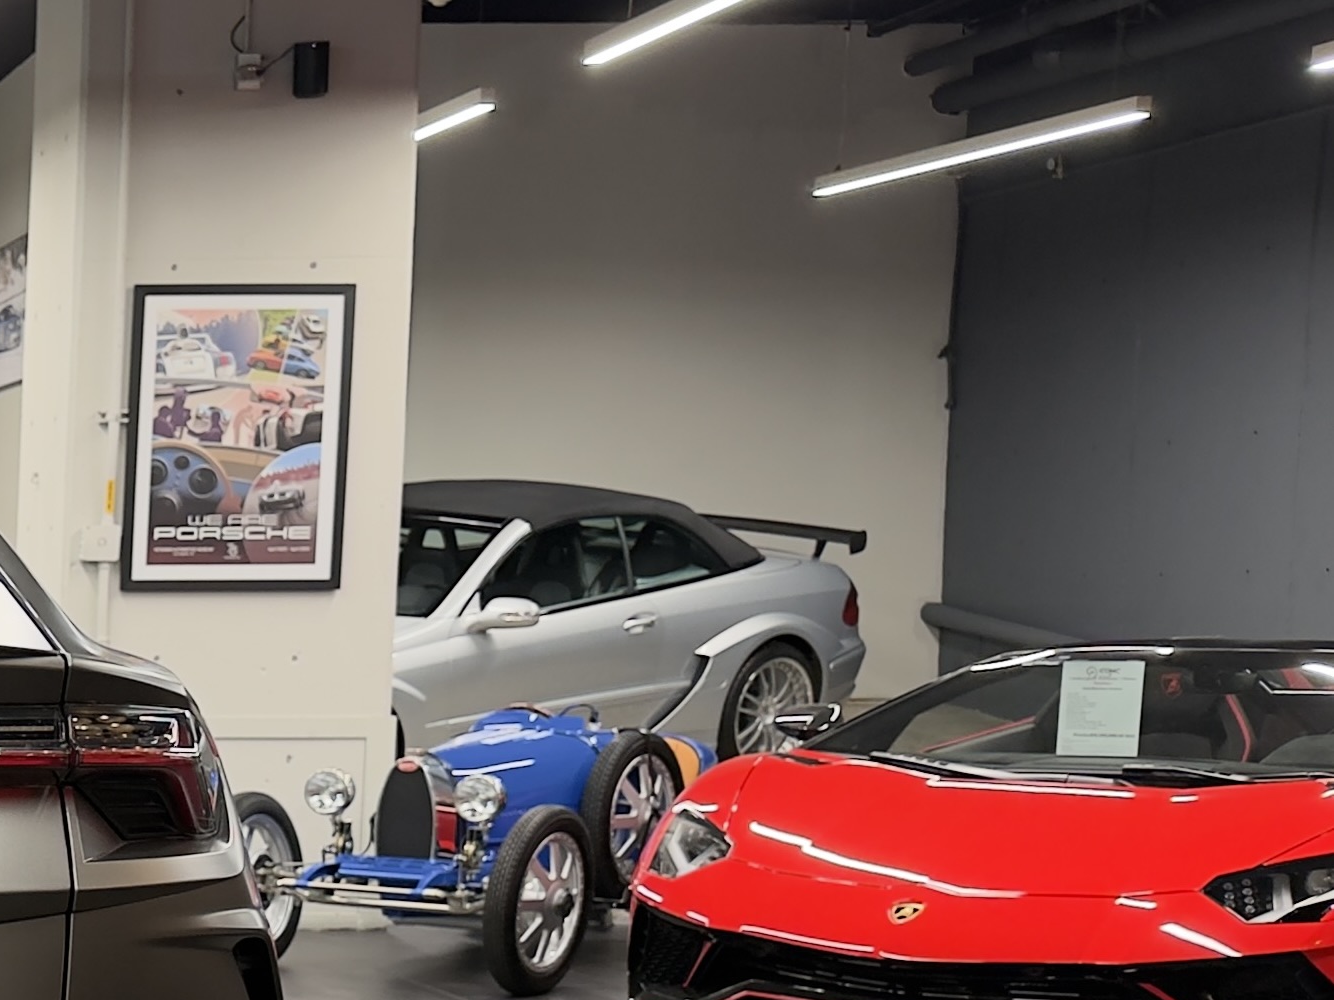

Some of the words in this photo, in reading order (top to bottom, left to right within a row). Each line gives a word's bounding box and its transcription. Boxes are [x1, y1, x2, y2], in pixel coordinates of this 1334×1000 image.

[187, 514, 223, 526] WE
[227, 514, 279, 526] ARE
[153, 526, 311, 541] PORSCHE
